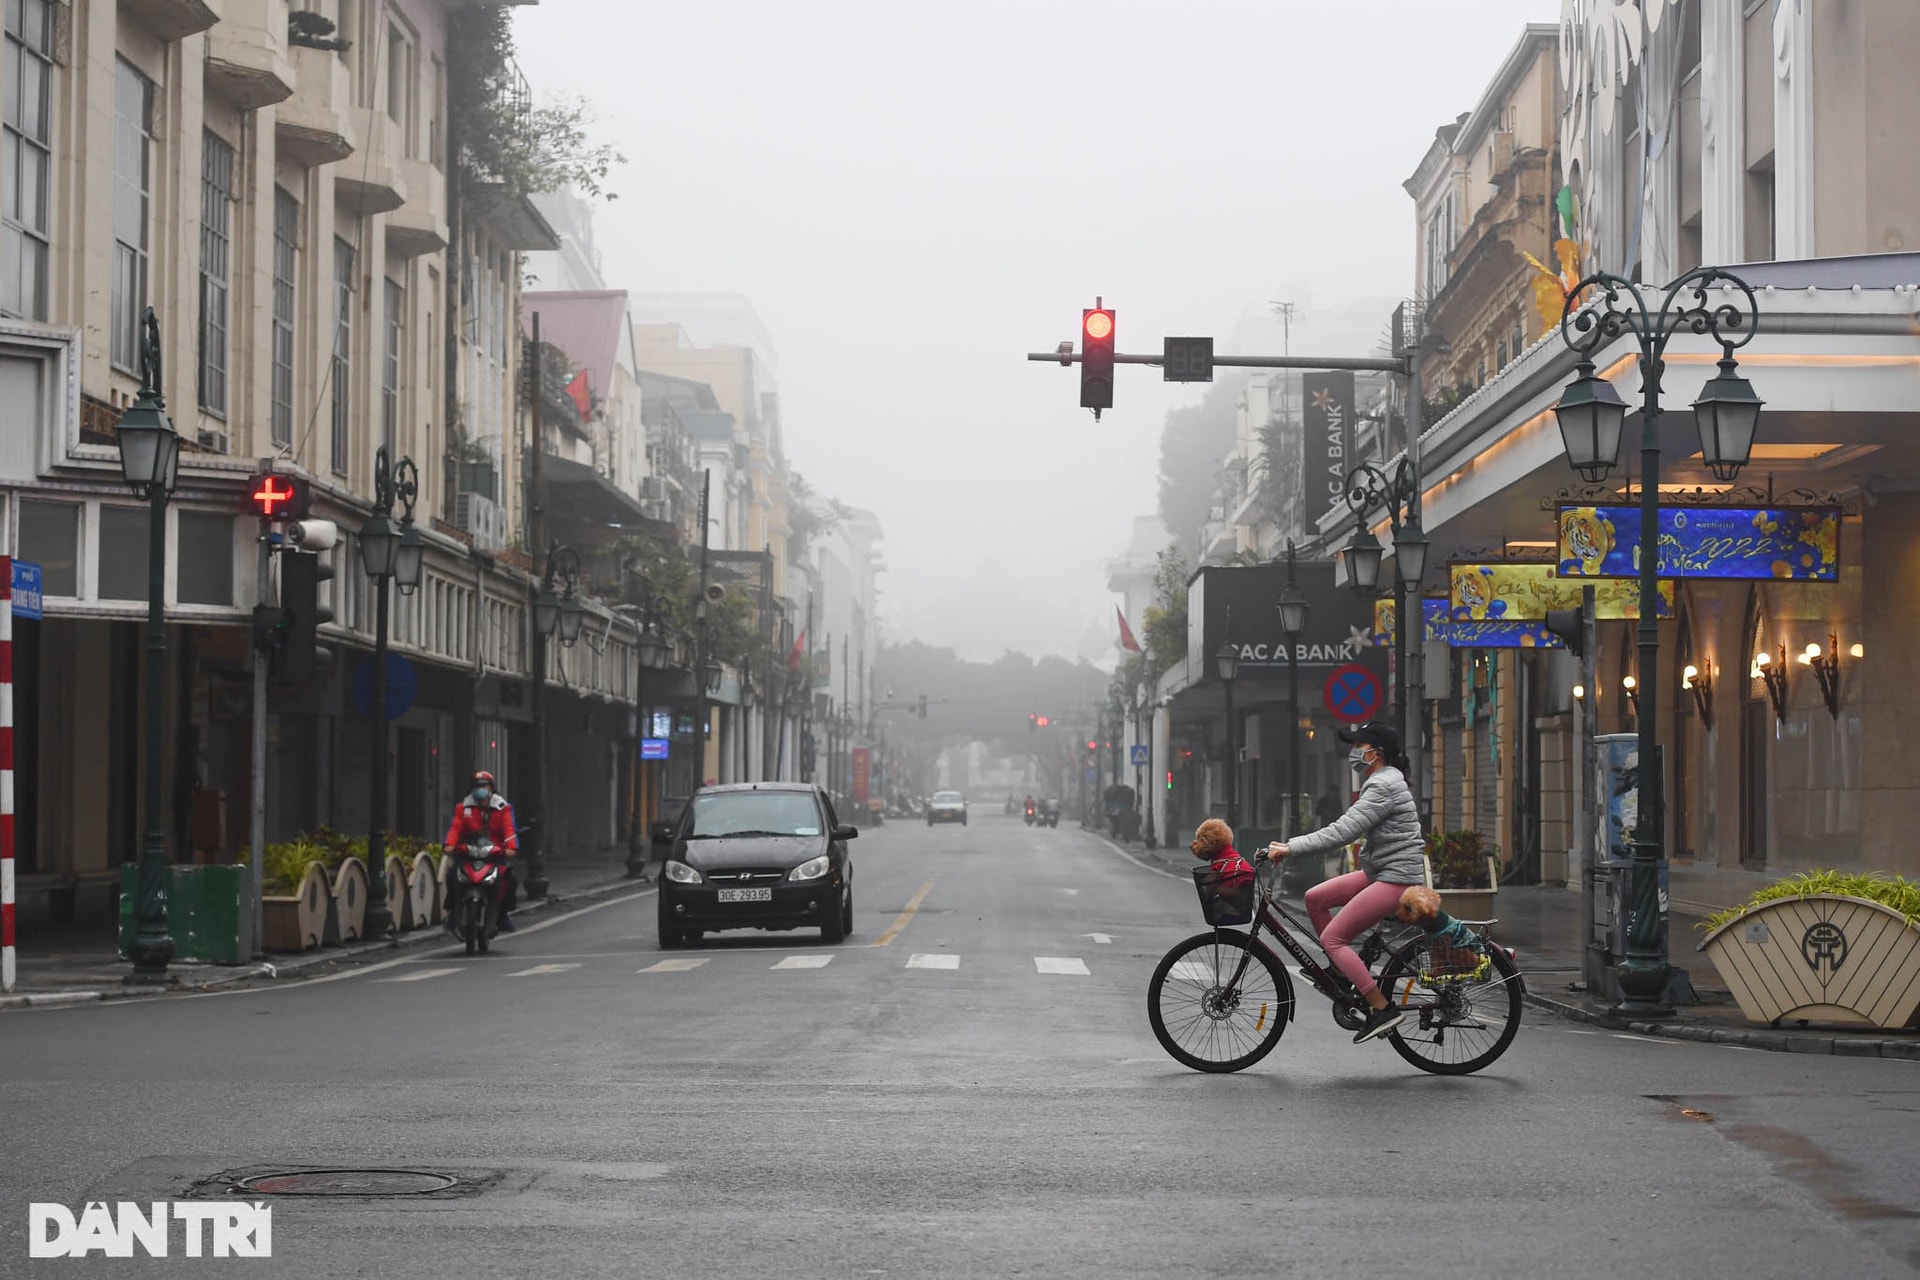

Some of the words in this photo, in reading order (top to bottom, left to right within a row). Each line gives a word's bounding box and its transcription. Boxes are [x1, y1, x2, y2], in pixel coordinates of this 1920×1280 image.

[1327, 404, 1343, 458] BANK
[1328, 462, 1343, 476] A
[1687, 536, 1773, 560] 2022
[1231, 644, 1268, 661] AC
[1273, 644, 1289, 660] A
[1296, 644, 1354, 661] BANK
